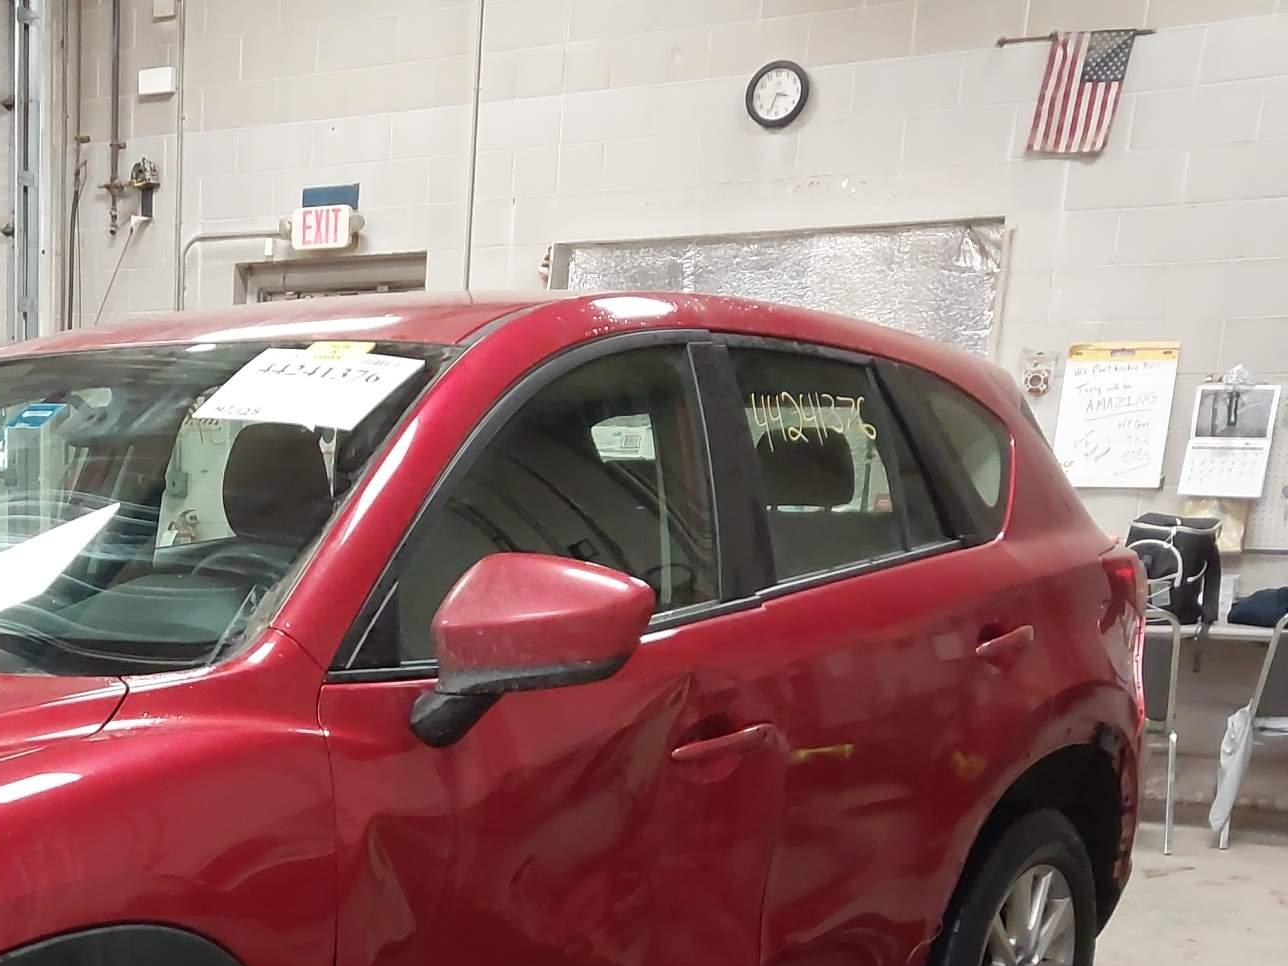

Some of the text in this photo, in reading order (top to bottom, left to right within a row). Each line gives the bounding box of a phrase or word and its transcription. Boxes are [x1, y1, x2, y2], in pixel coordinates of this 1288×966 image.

[302, 207, 342, 246] EXIT
[257, 362, 381, 384] 44241376
[751, 391, 877, 453] 44241376
